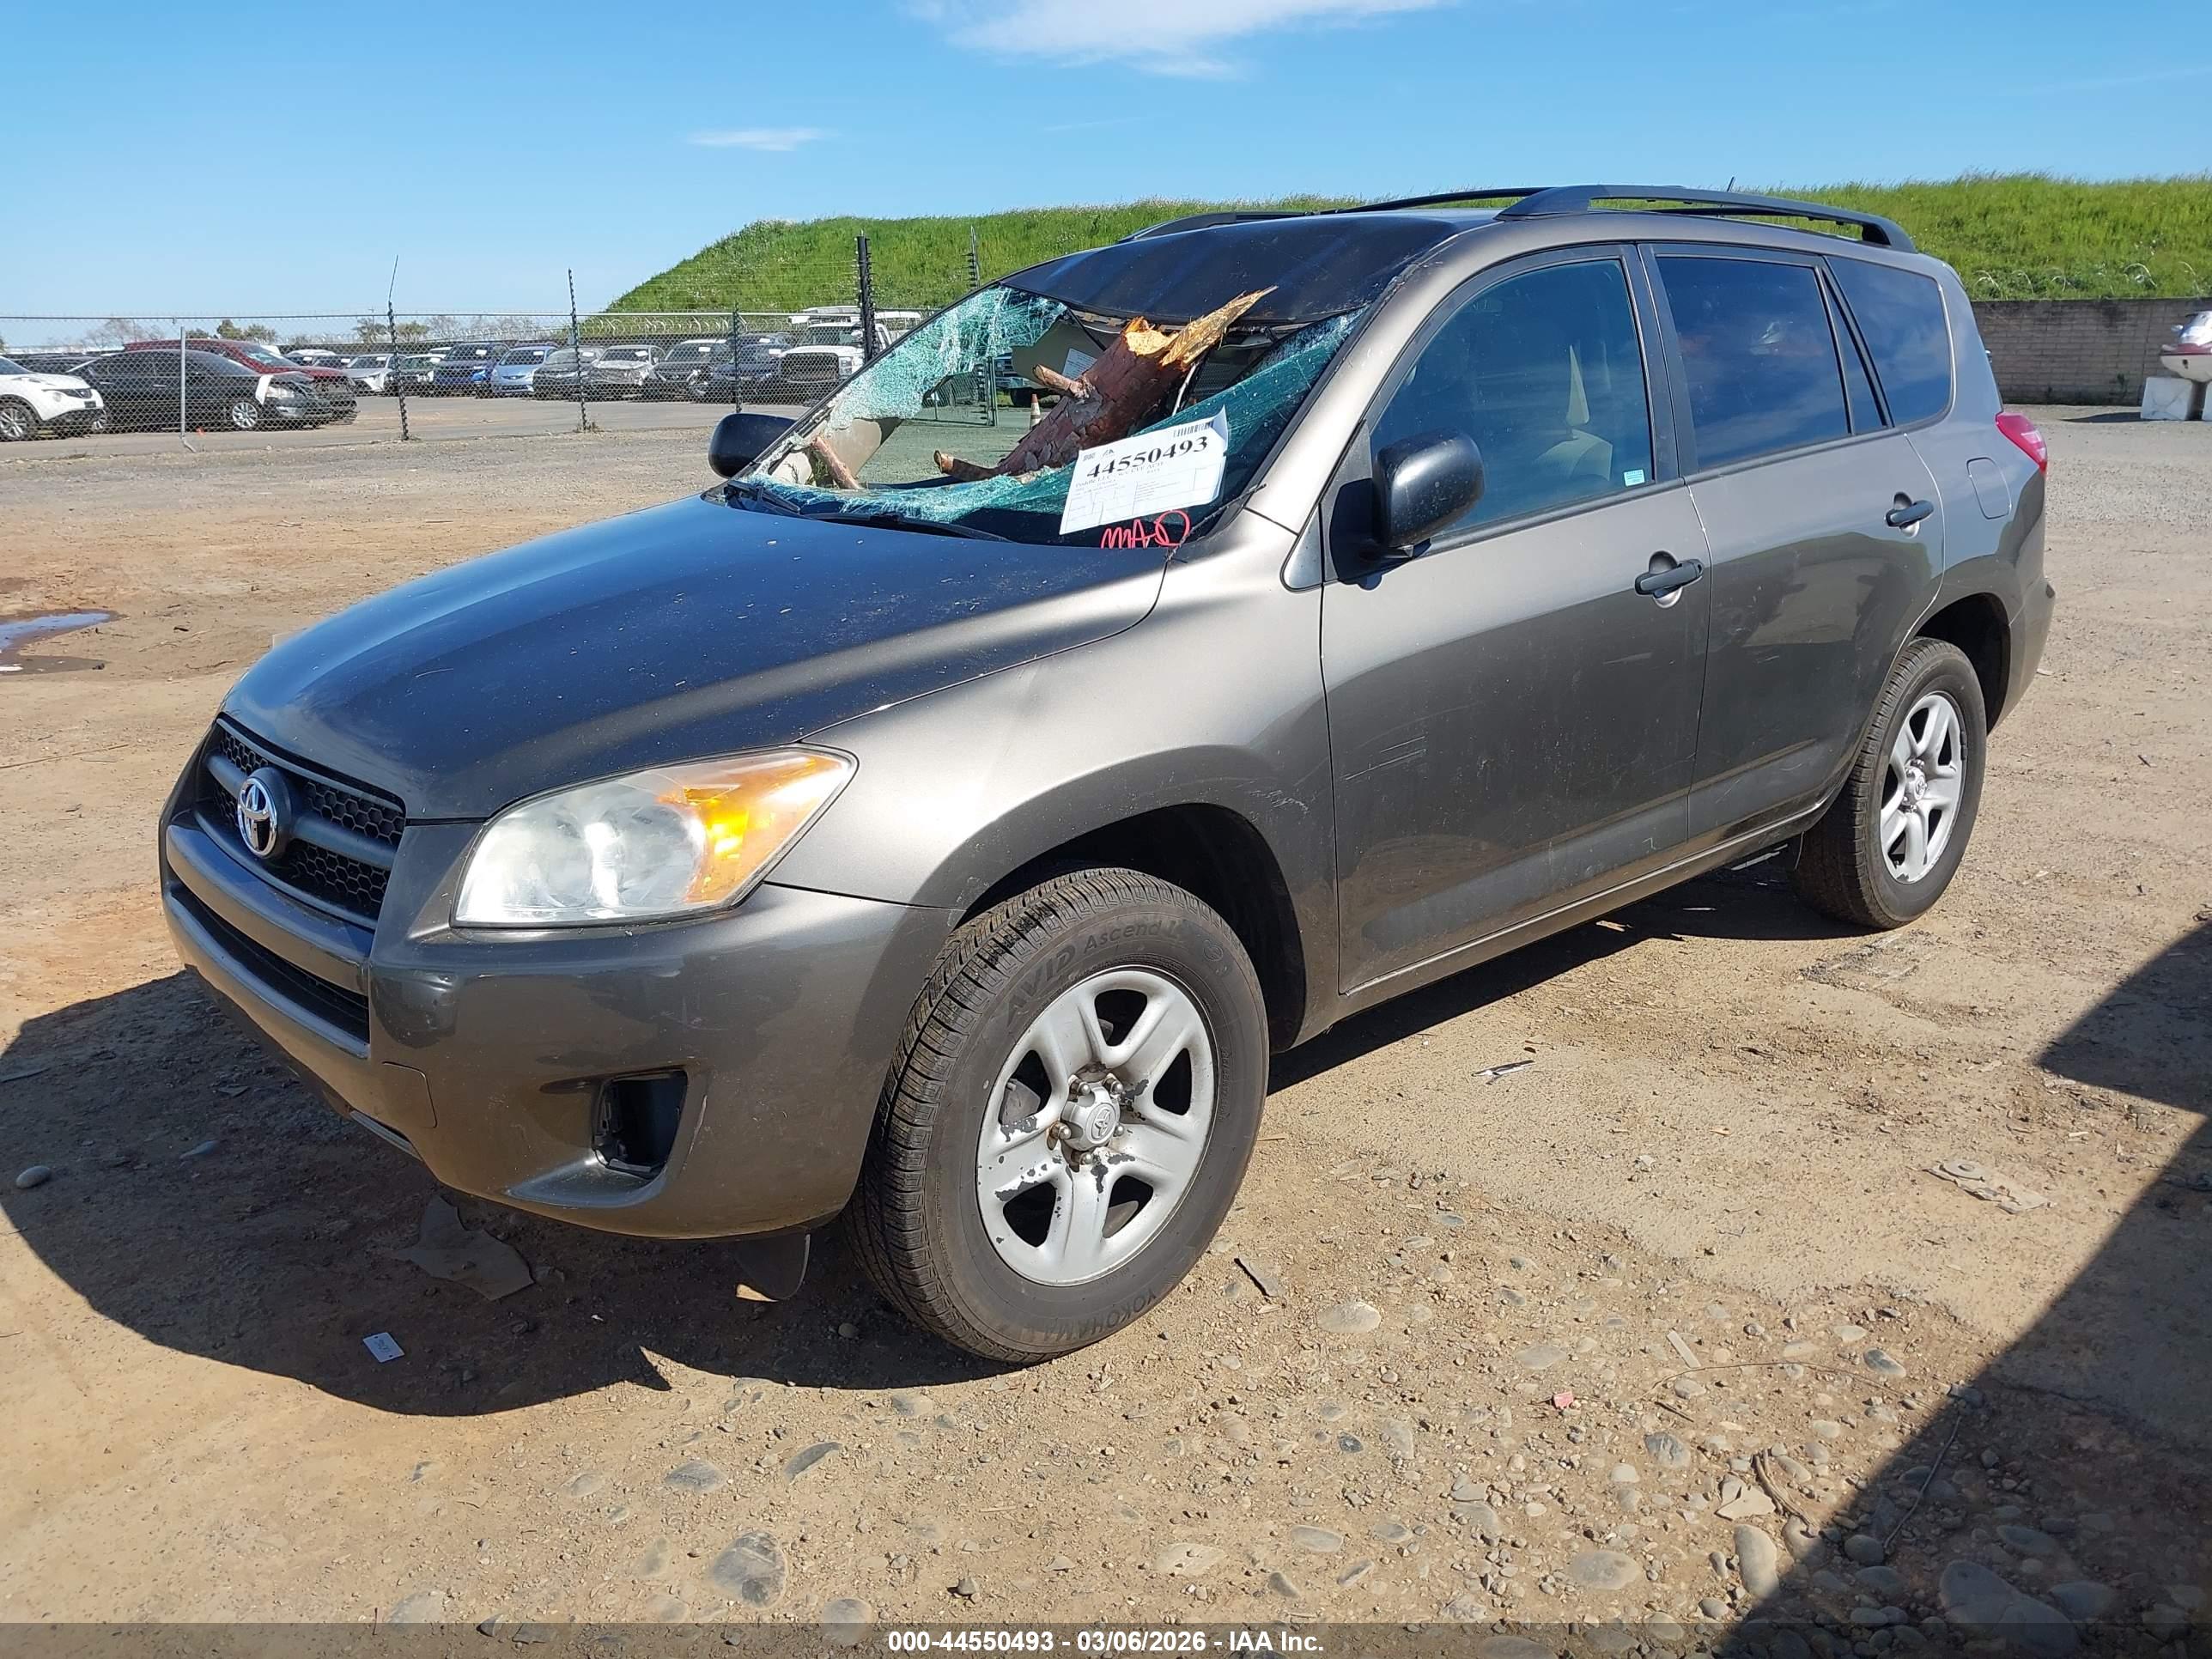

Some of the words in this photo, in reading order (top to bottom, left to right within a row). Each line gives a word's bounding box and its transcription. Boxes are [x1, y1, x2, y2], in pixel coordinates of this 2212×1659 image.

[1086, 435, 1208, 478] 44550493
[1006, 945, 1077, 1028] AVID
[1084, 921, 1162, 953] Ascend
